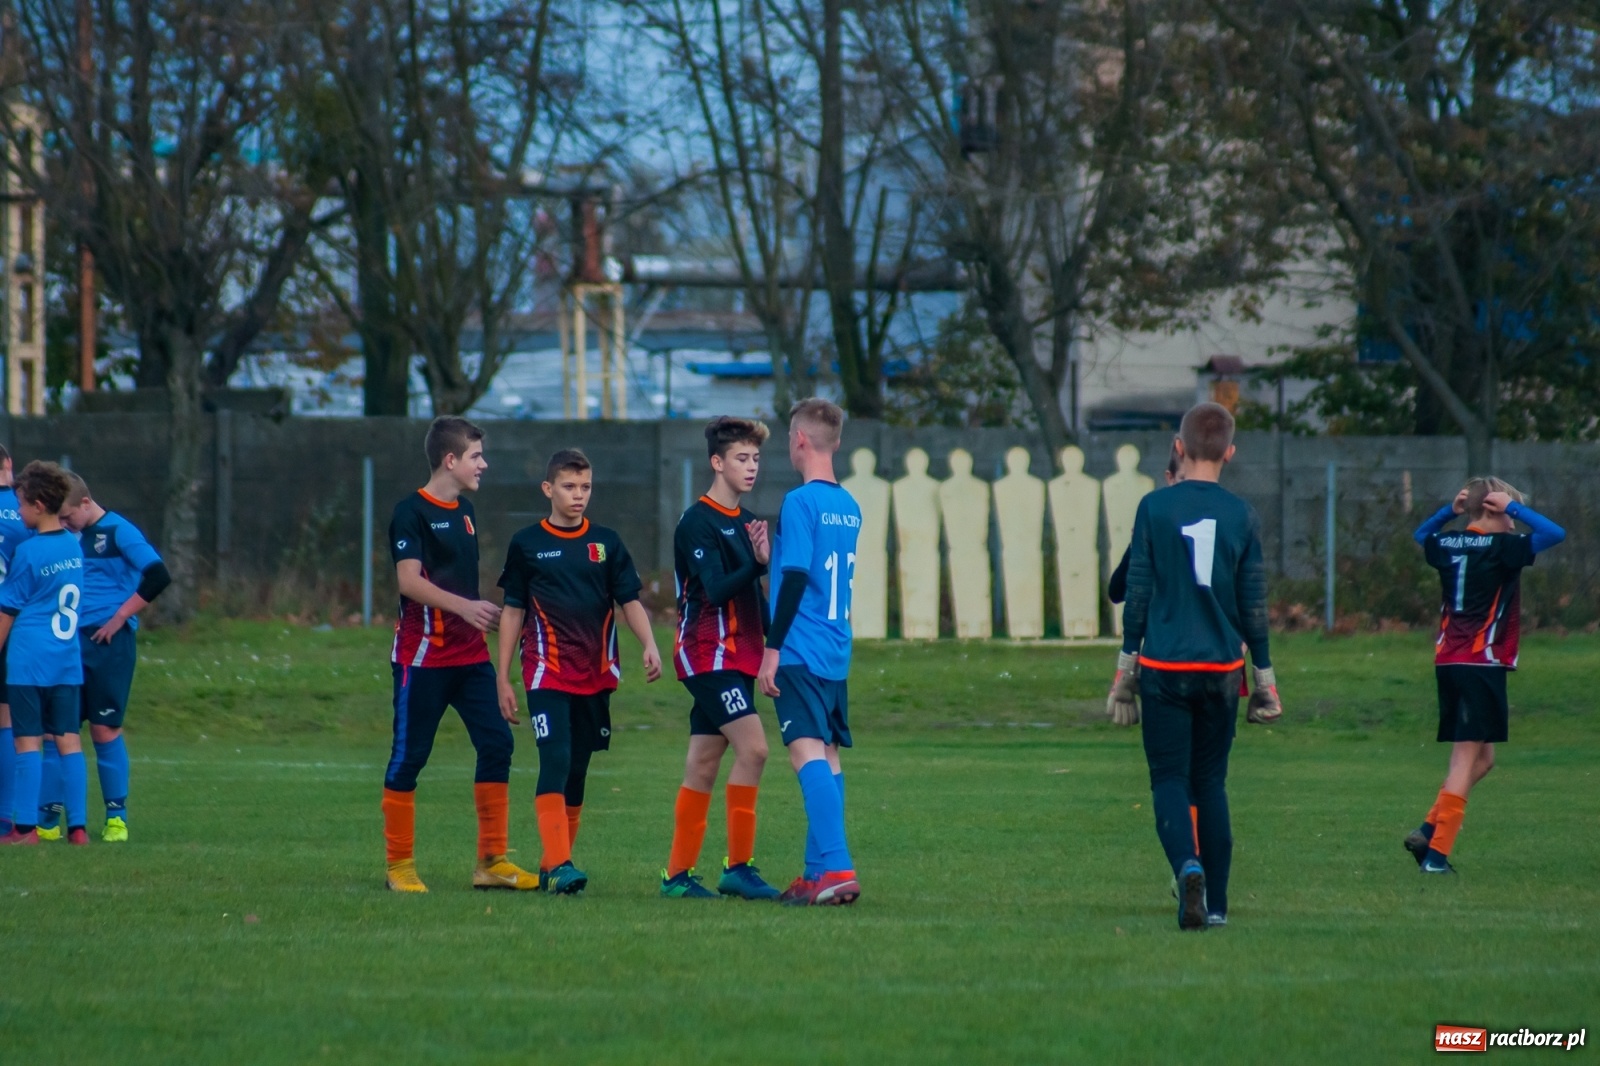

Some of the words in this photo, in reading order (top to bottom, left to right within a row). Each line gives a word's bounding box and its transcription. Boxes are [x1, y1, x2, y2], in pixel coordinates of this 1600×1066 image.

[543, 550, 562, 558] VIGO
[1181, 518, 1217, 588] 1
[51, 583, 81, 640] 8
[720, 687, 748, 715] 23
[531, 713, 549, 740] 33
